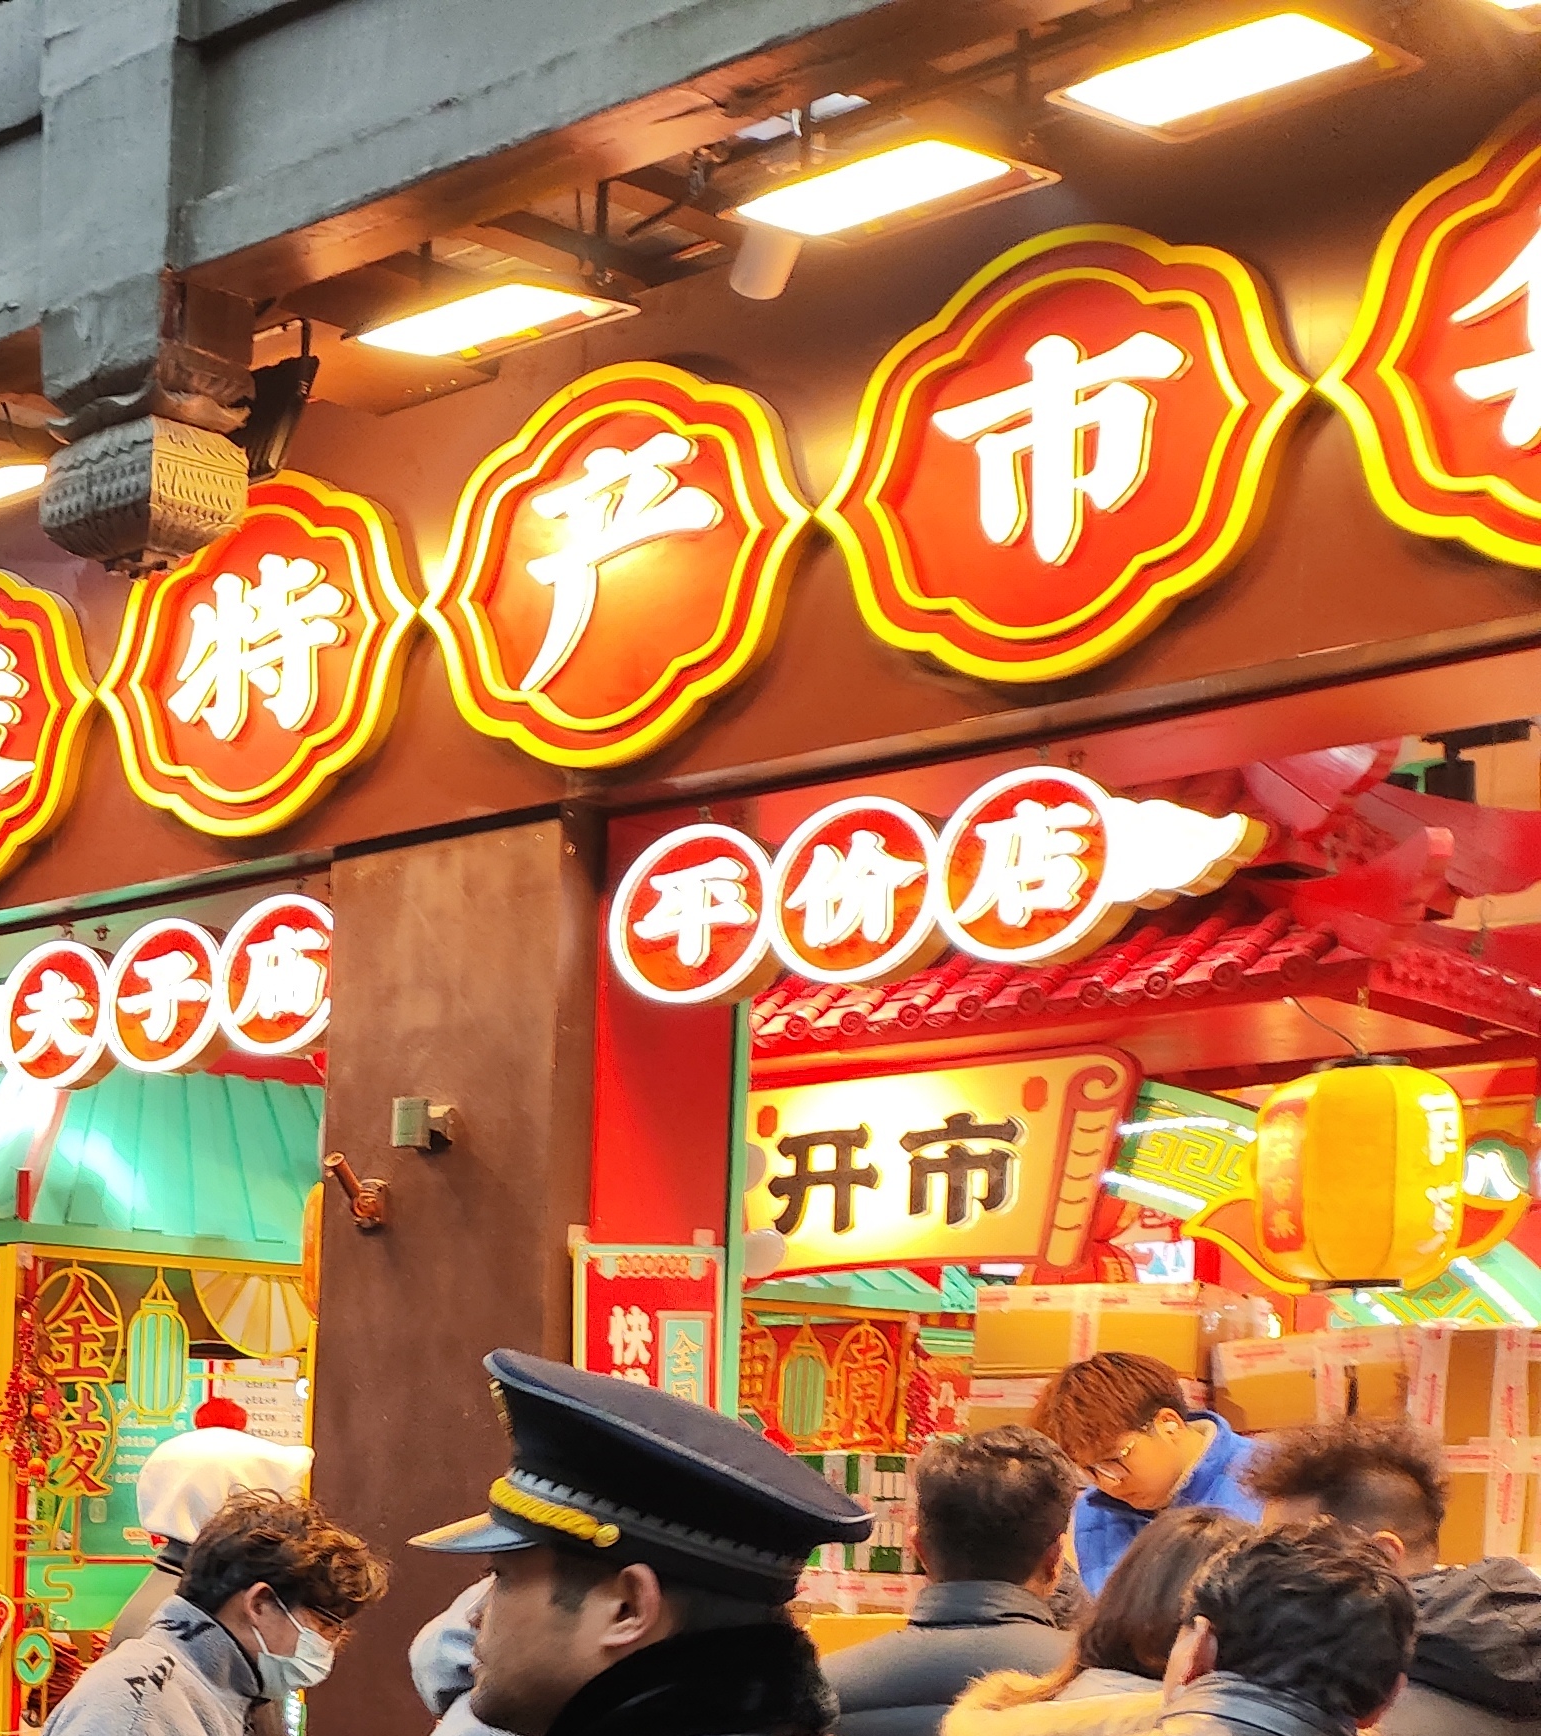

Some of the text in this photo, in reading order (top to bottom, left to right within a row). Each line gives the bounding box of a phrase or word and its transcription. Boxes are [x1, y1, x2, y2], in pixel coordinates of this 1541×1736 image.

[633, 798, 1101, 967] 平价店
[766, 1111, 1024, 1235] 开市
